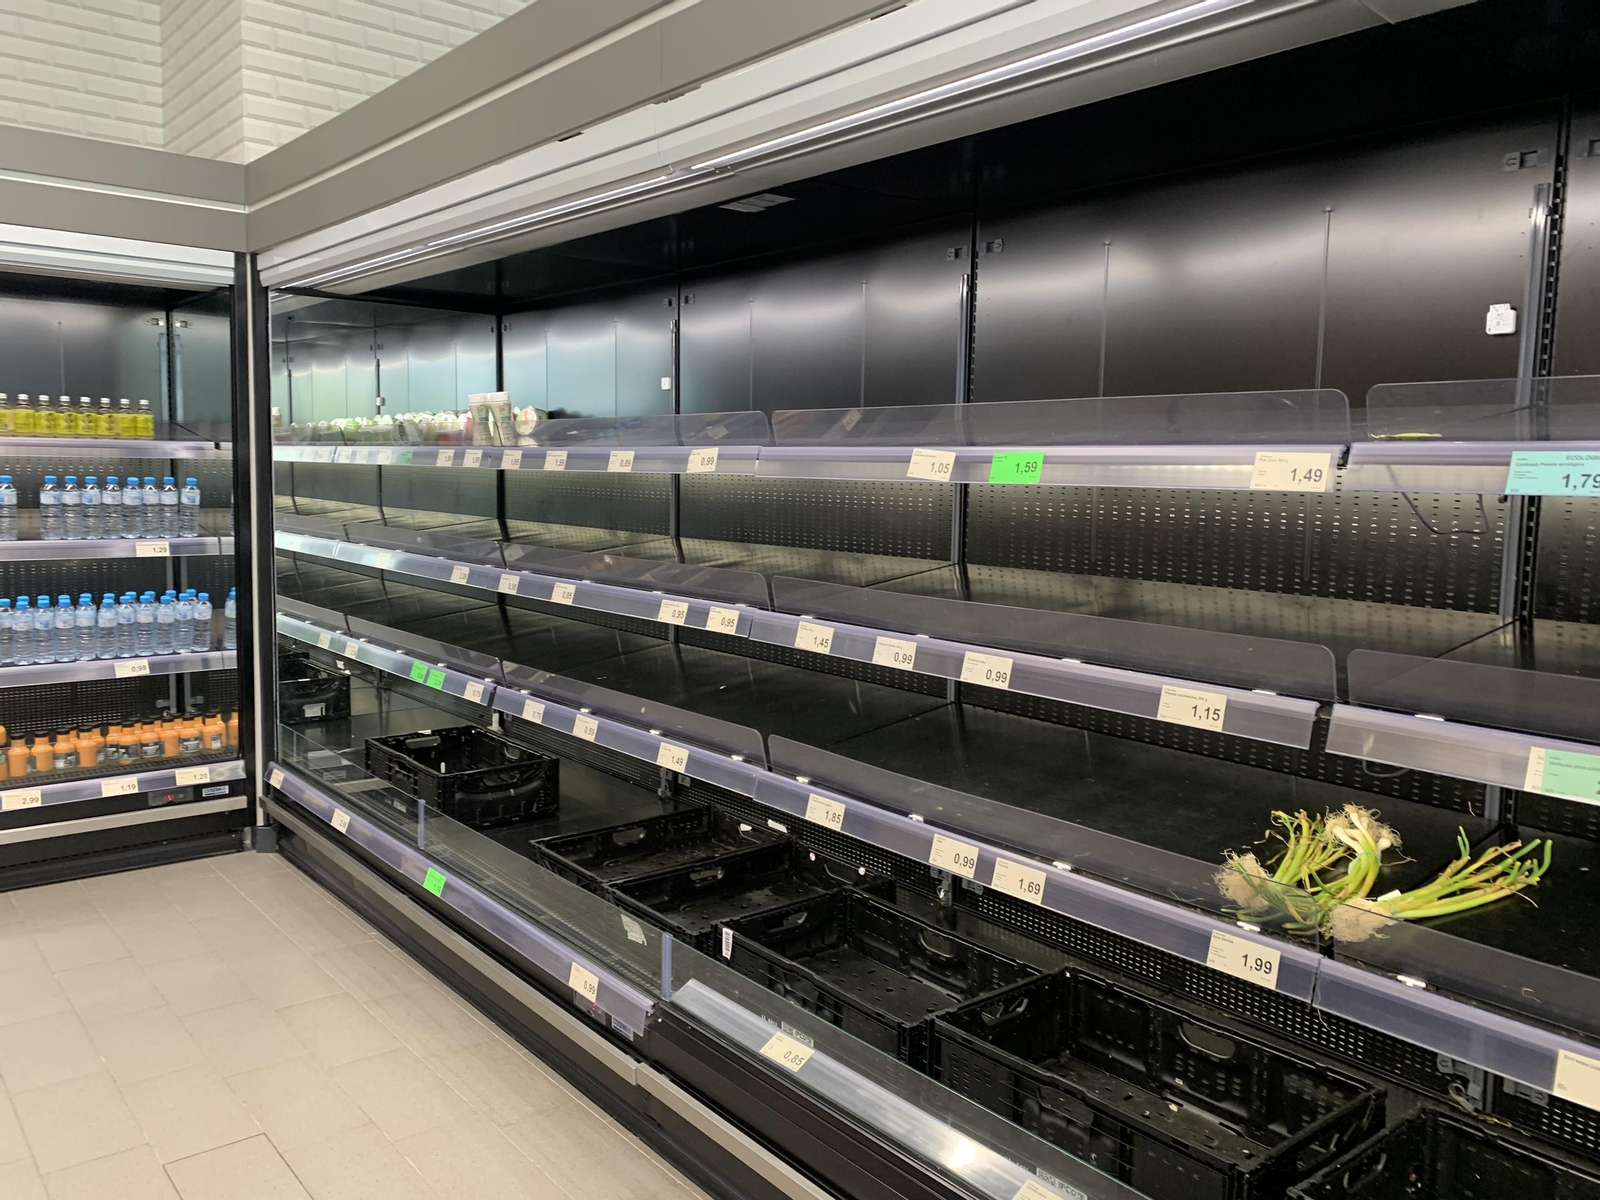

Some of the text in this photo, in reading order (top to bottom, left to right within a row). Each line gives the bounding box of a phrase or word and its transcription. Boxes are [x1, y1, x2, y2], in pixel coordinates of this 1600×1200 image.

[701, 456, 715, 466] 0,99
[930, 461, 950, 475] 1,05
[1015, 461, 1038, 475] 1,59
[1290, 467, 1323, 484] 1,49
[1563, 473, 1600, 491] 1,79
[153, 546, 167, 554] 1,29
[672, 609, 685, 619] 0,95
[721, 617, 735, 627] 0,95
[813, 636, 829, 648] 1,45
[894, 651, 913, 664] 0,99
[131, 664, 147, 672] 0,99
[986, 669, 1008, 684] 0,99
[1192, 704, 1221, 722] 1,15
[121, 784, 136, 792] 1,19
[22, 796, 39, 805] 2,99
[825, 810, 842, 825] 1,85
[954, 853, 975, 869] 0,99
[1018, 878, 1041, 895] 1,69
[1242, 953, 1273, 975] 1,99
[584, 980, 595, 995] 0,99
[783, 1050, 805, 1066] 0,85
